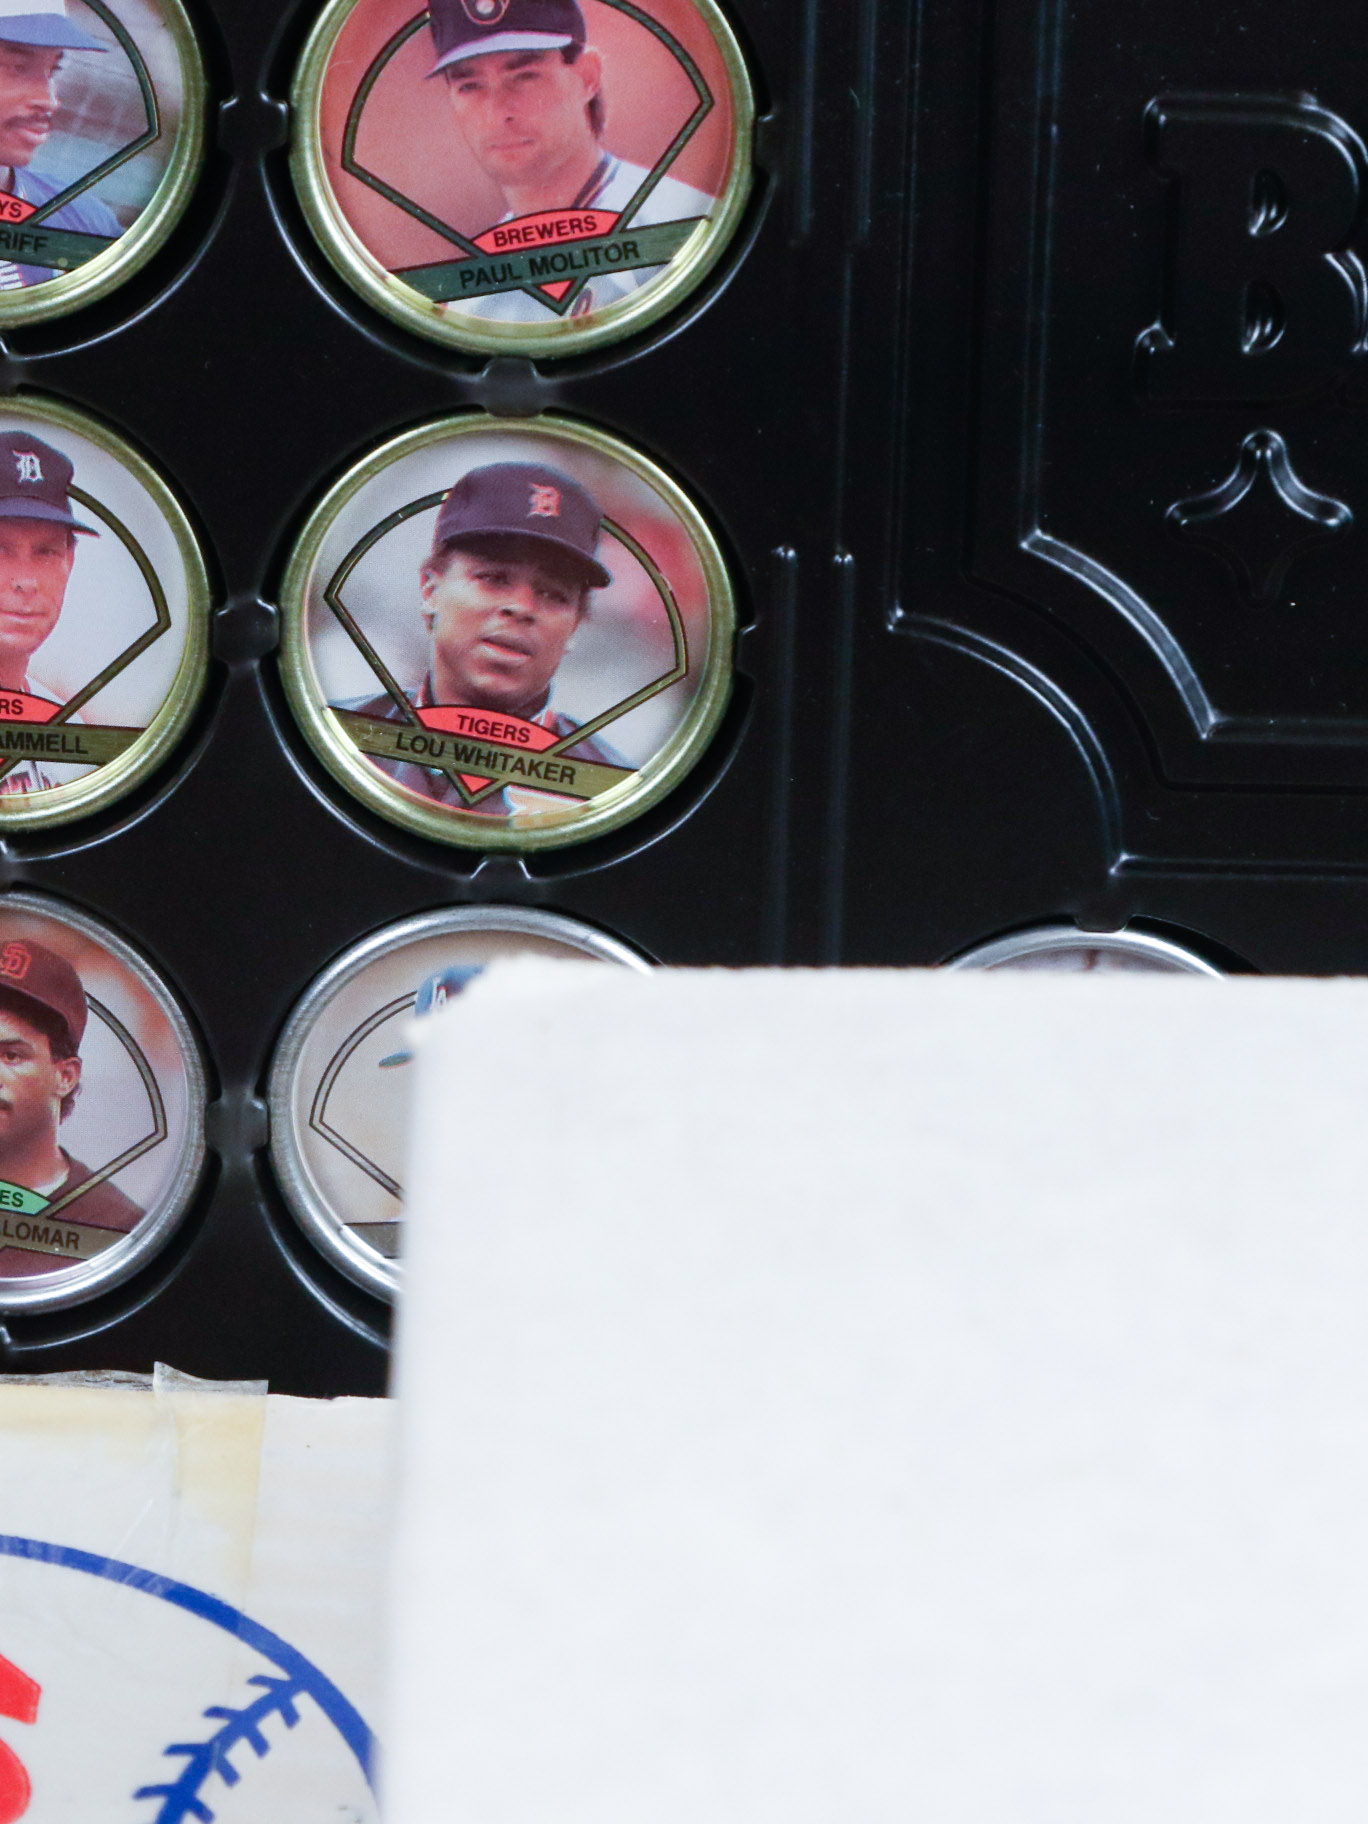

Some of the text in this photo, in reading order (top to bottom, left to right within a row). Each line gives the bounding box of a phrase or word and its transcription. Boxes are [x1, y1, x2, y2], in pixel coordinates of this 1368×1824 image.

[493, 215, 597, 247] BREWERS
[459, 240, 640, 289] PAUL MOLITOR
[457, 714, 531, 743] TIGERS
[396, 732, 576, 785] LOU WHITAKER
